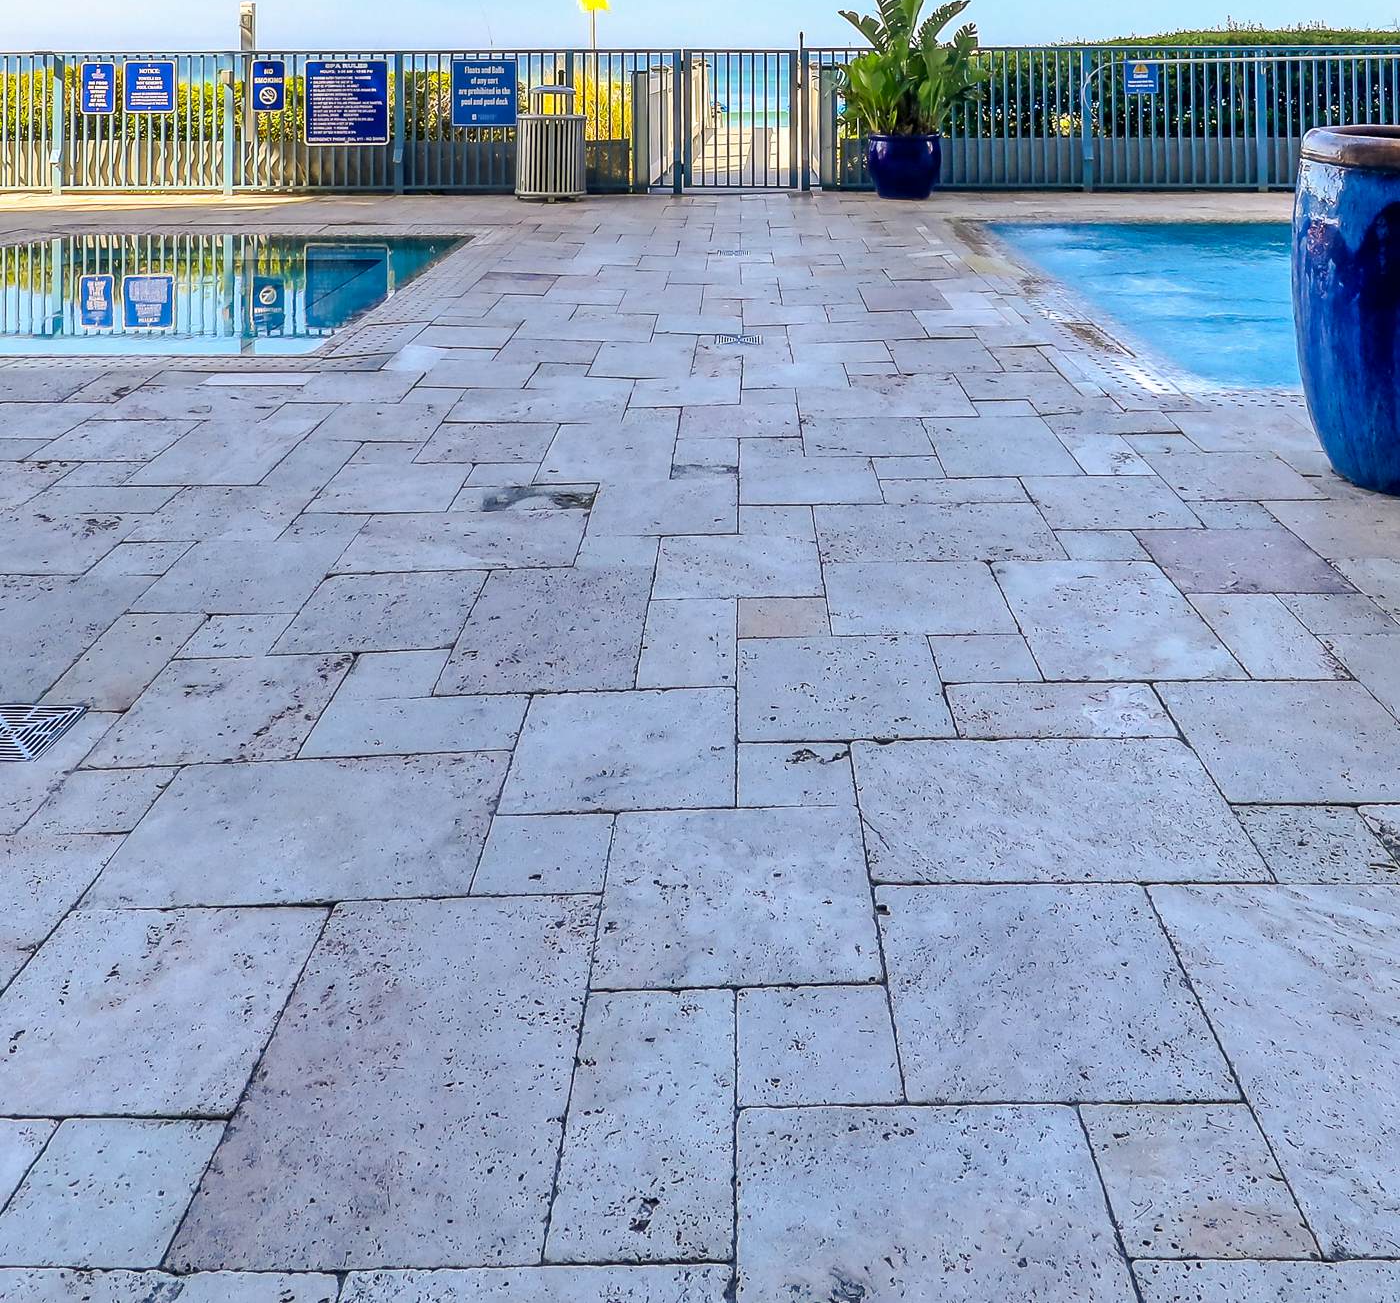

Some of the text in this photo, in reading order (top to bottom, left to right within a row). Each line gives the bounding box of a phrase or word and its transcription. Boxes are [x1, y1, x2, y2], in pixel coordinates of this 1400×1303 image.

[468, 87, 495, 96] prohibited
[461, 98, 472, 106] pool
[484, 98, 495, 106] pool
